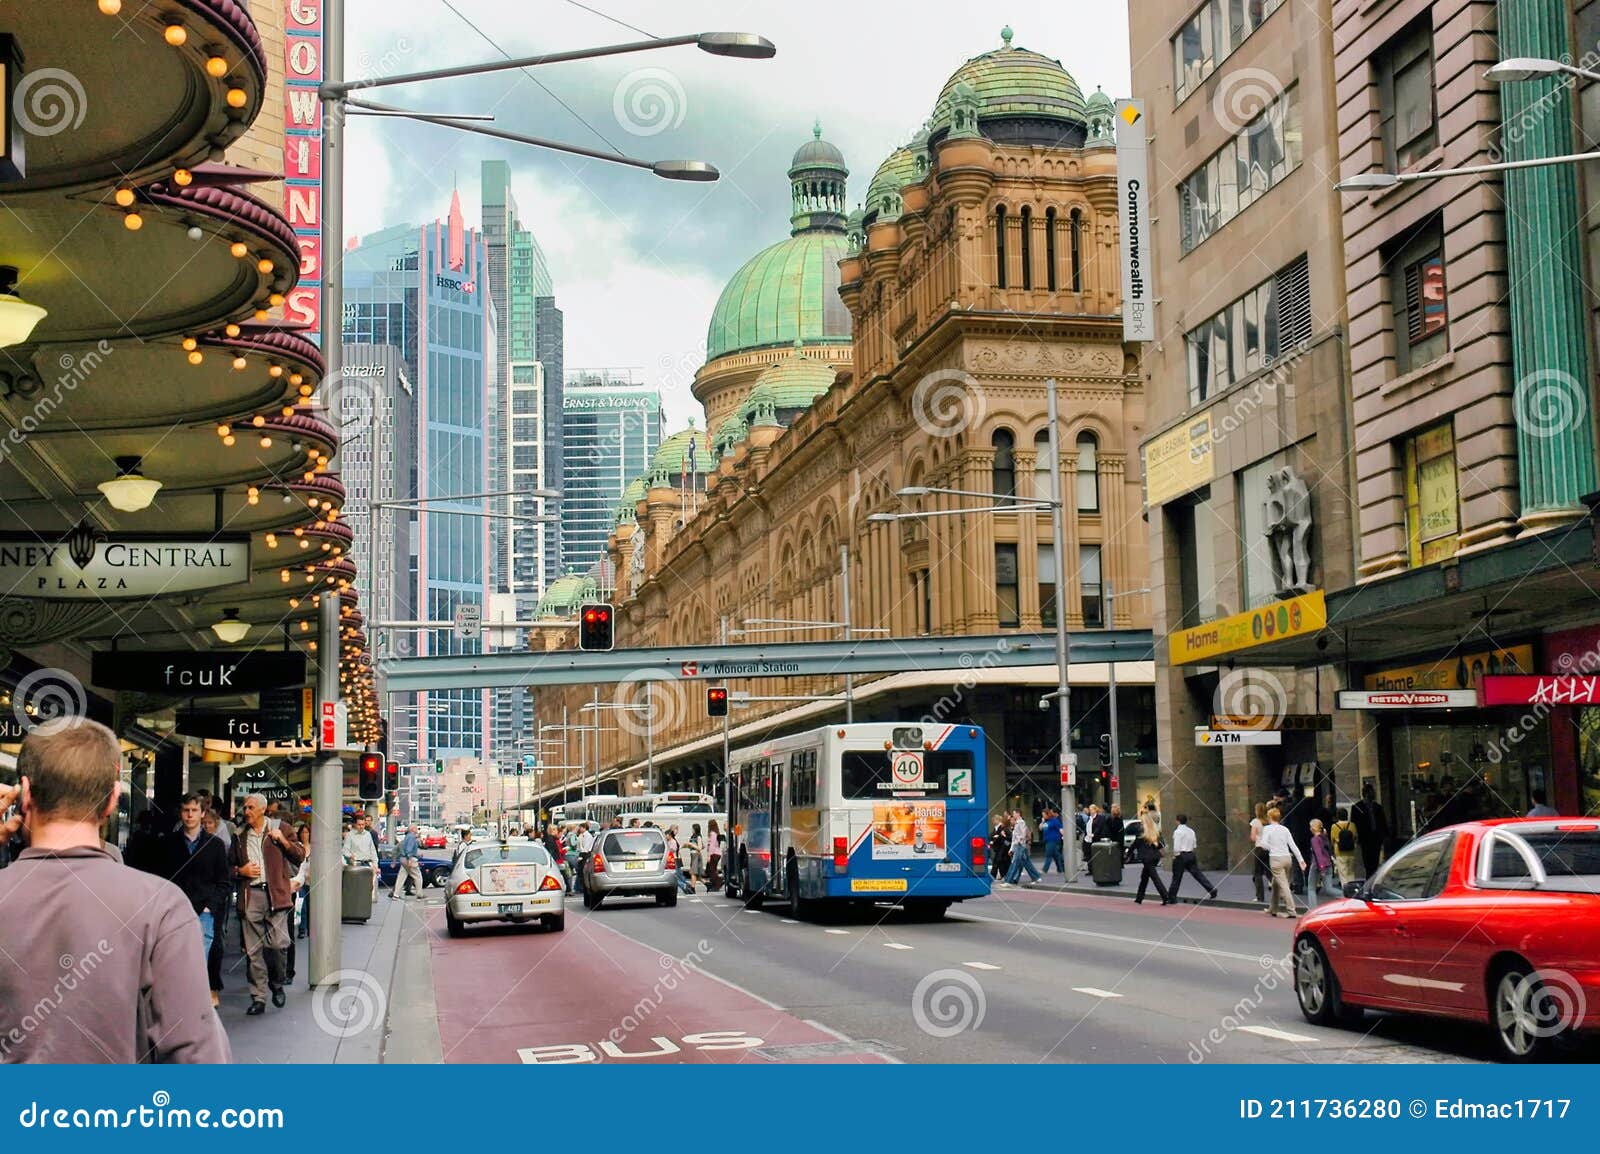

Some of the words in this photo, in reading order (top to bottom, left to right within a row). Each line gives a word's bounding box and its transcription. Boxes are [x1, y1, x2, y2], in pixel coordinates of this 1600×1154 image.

[288, 0, 318, 325] GOWINGS
[1127, 179, 1143, 299] Commonwealth
[436, 275, 462, 291] HSBC
[1132, 302, 1146, 334] Bank
[341, 362, 386, 377] stralia
[562, 397, 597, 408] ERNST
[597, 399, 606, 408] &
[607, 396, 649, 408] YOUNG
[105, 544, 232, 567] CENTRAL
[38, 577, 128, 589] PLAZA
[164, 665, 233, 686] fcuk
[714, 662, 759, 675] Monorail
[762, 662, 799, 673] Station
[1371, 693, 1446, 705] RETRAVISION
[1214, 733, 1241, 743] ATM
[897, 760, 919, 775] 40
[517, 1031, 765, 1064] BUS
